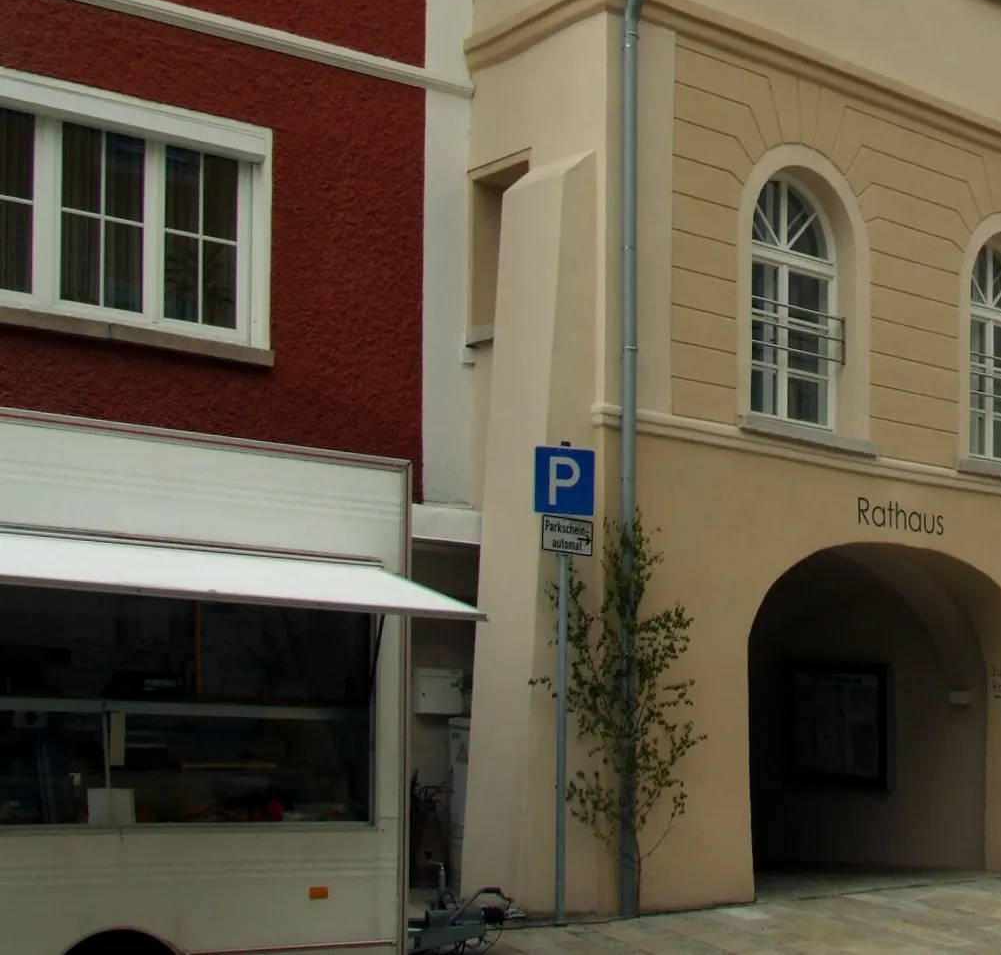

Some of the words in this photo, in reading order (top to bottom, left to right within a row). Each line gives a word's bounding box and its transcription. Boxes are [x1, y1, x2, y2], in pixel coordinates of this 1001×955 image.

[548, 456, 581, 506] P
[545, 519, 590, 536] Parkschein-
[857, 496, 944, 536] Rathaus
[552, 538, 583, 551] automat
